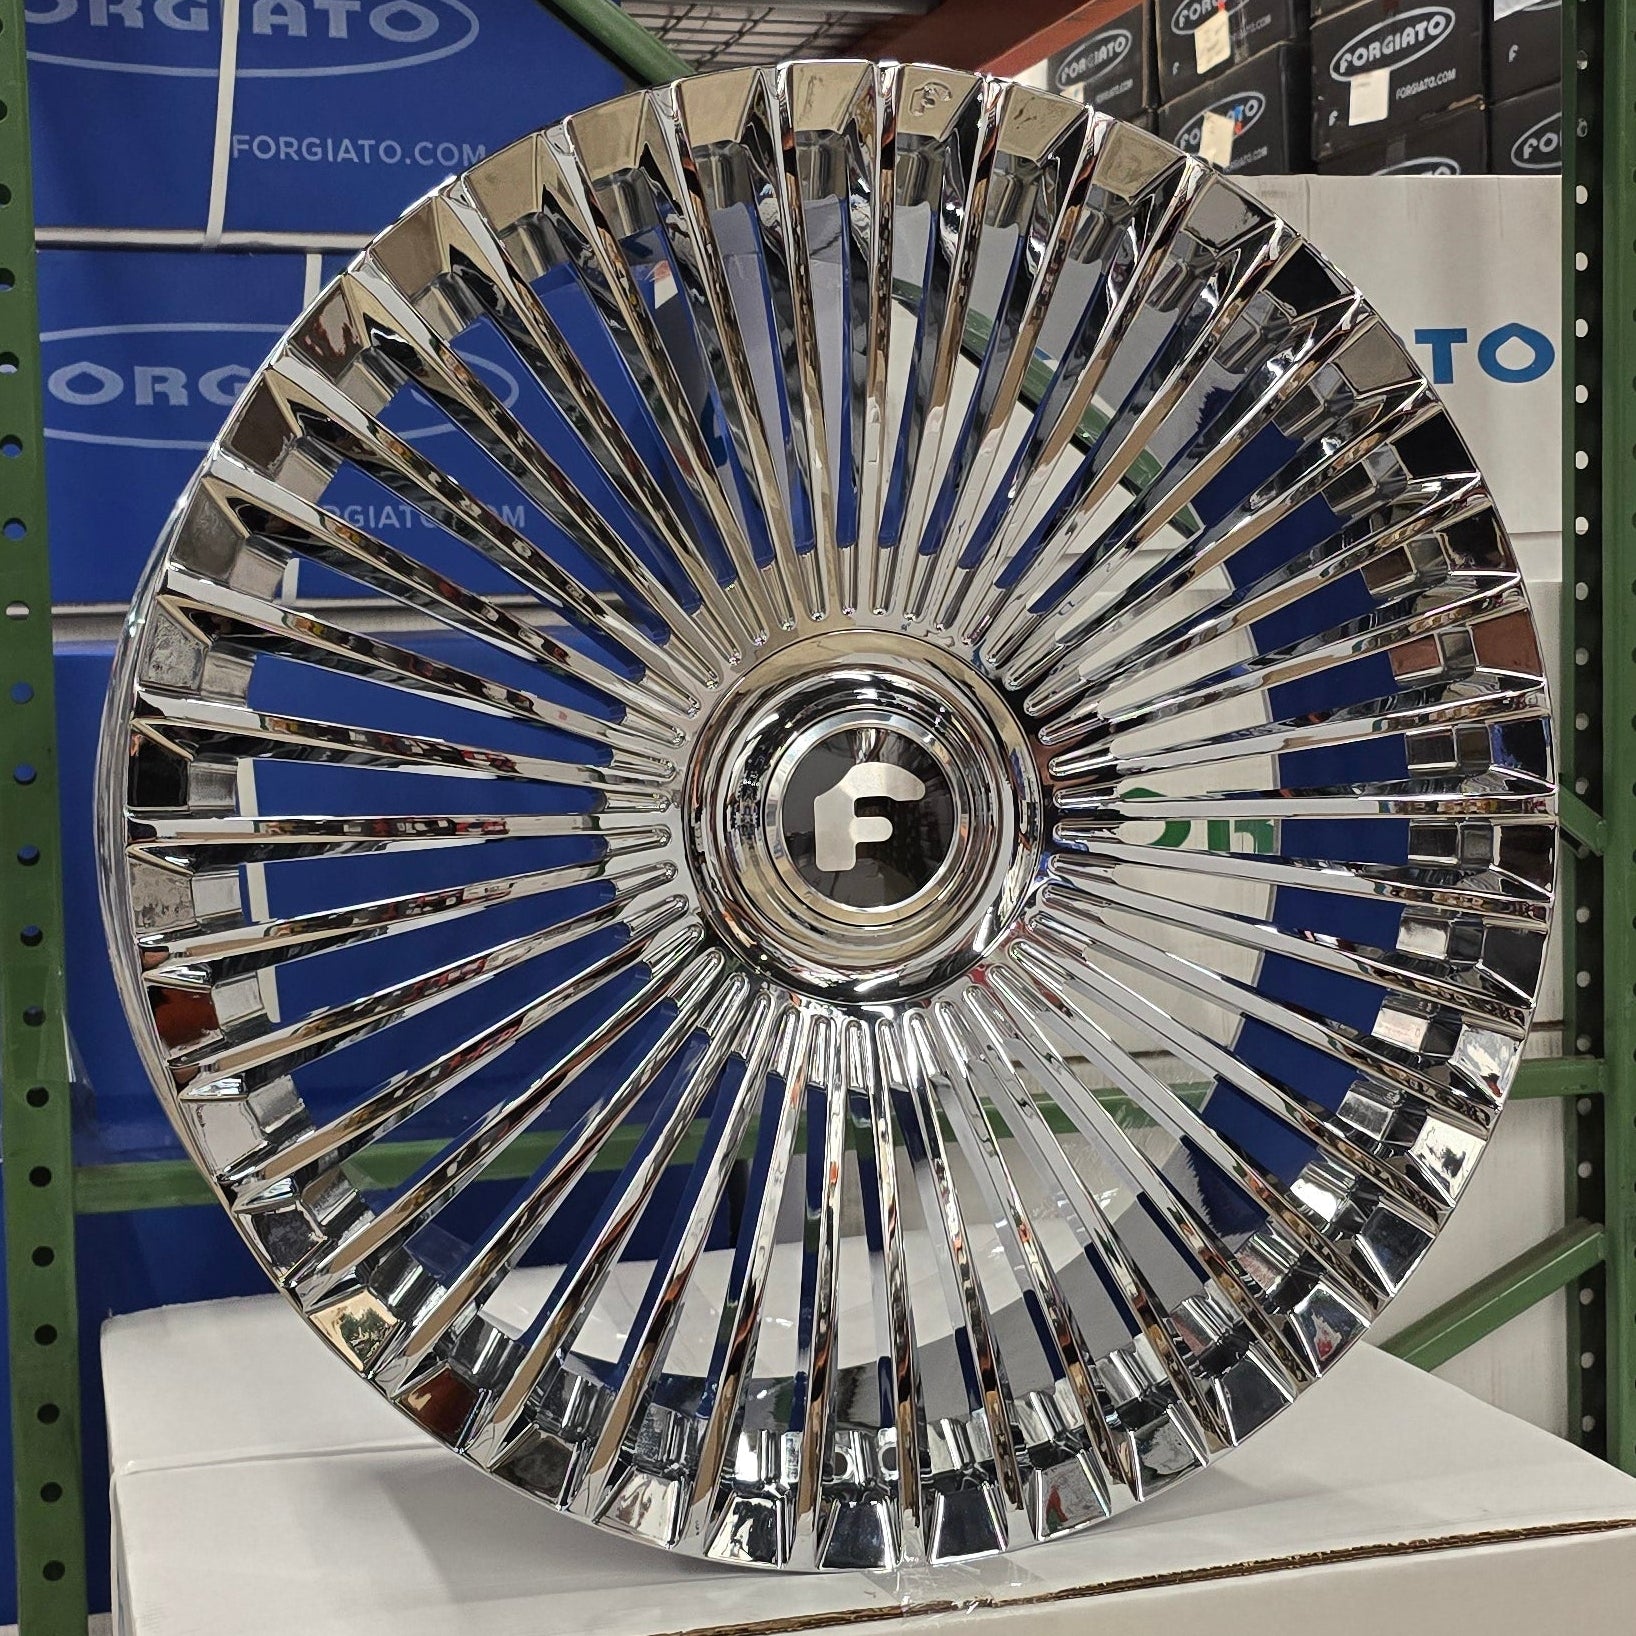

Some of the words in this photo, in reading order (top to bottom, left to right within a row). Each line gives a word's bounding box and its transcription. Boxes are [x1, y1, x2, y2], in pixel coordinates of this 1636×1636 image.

[1061, 36, 1126, 84] FORGIATO
[1339, 14, 1447, 74] FORGIATO
[1395, 68, 1457, 100] FORGIATO.COM
[232, 134, 487, 167] FORGIATO.COM
